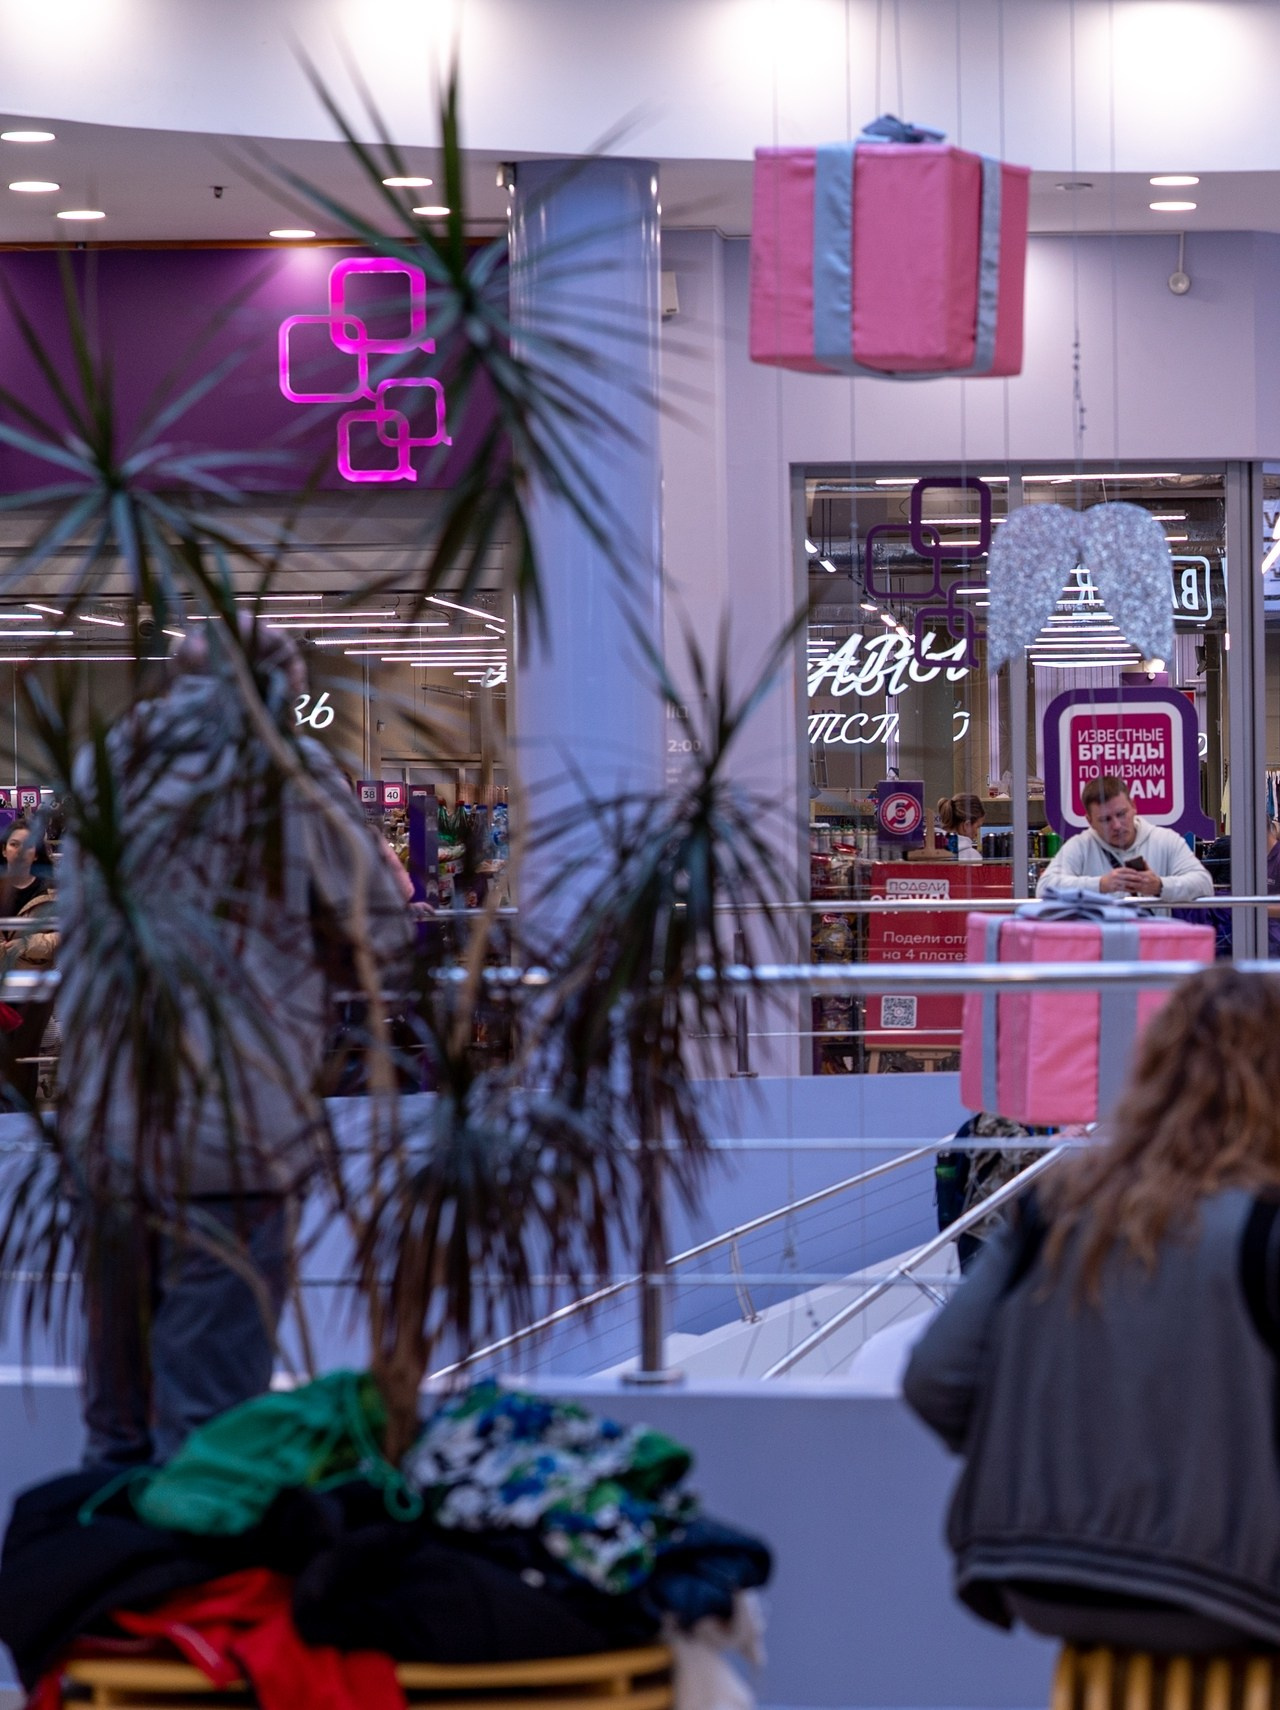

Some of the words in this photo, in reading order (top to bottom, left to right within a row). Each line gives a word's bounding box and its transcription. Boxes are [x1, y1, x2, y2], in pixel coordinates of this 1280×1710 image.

[1077, 728, 1164, 743] ИЗВЕСТНЫЕ
[1078, 743, 1165, 763] БРЕНДЫ
[1079, 765, 1099, 779] ПО
[1104, 763, 1165, 778] НИЗКИМ
[23, 795, 35, 804] 38
[363, 790, 375, 799] 38
[386, 791, 399, 799] 40
[883, 931, 940, 944] Подели
[882, 952, 901, 961] на
[905, 949, 915, 960] 4
